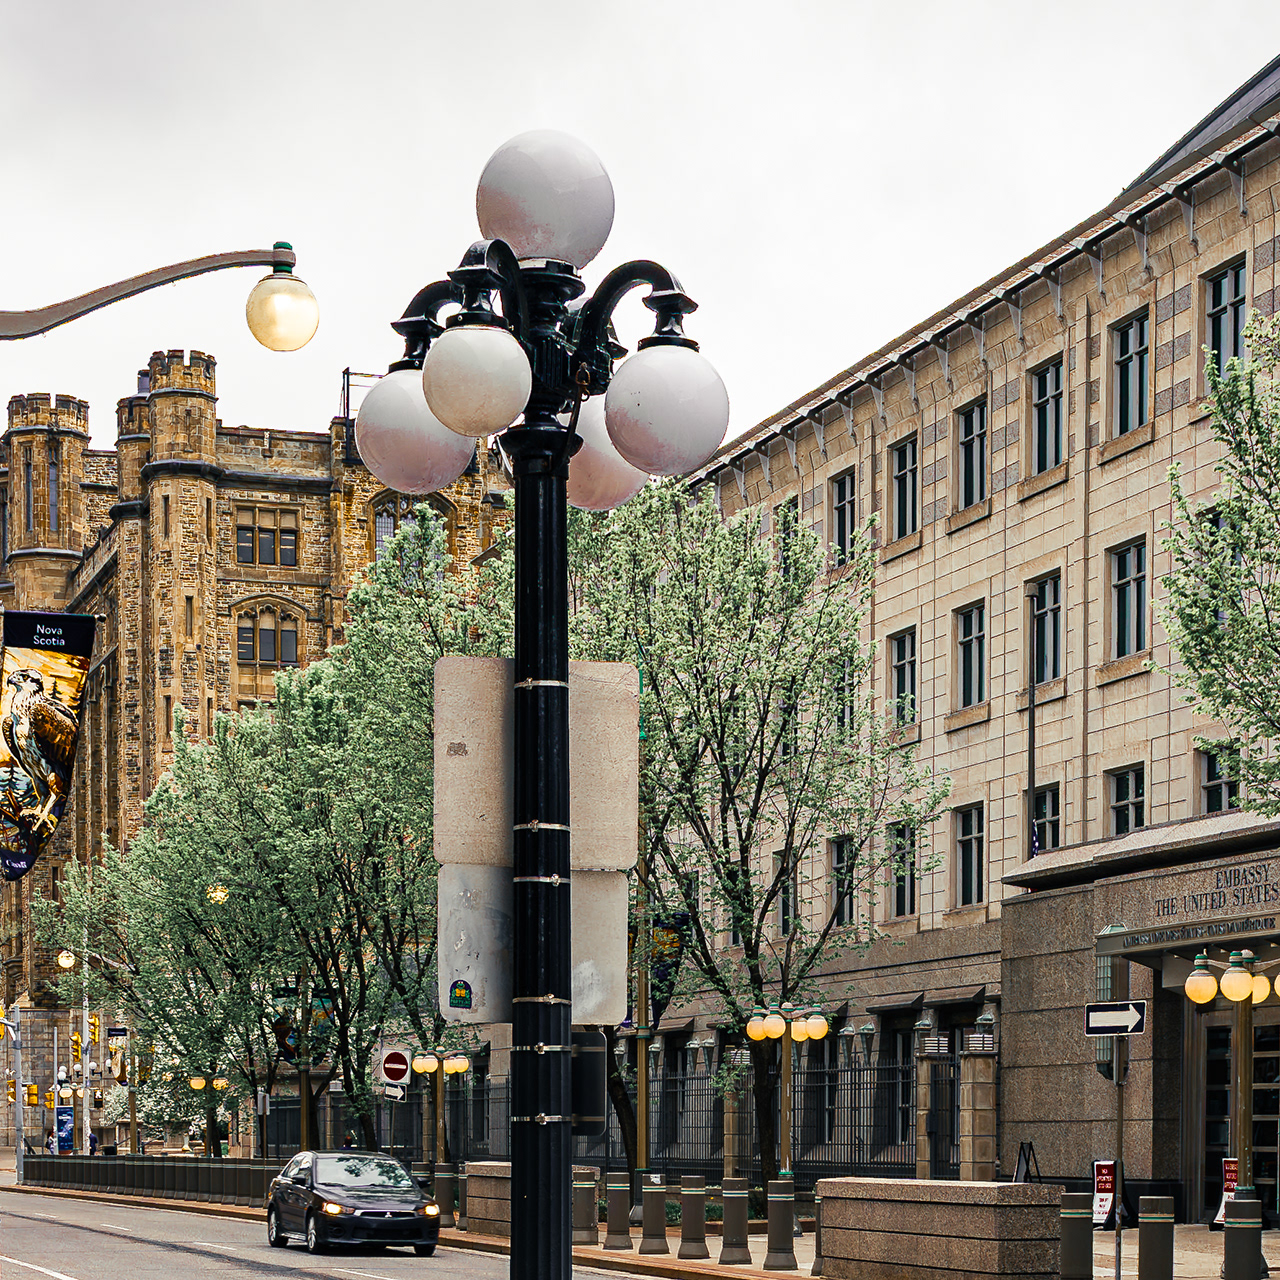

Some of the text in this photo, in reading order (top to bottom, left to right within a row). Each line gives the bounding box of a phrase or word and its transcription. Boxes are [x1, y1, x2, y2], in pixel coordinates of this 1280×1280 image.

[36, 624, 63, 635] Nova
[33, 635, 65, 646] Scotia
[1215, 864, 1271, 890] EMBASSY
[1155, 897, 1178, 917] THE
[1183, 891, 1226, 914] UNITED
[1233, 881, 1280, 907] STATES
